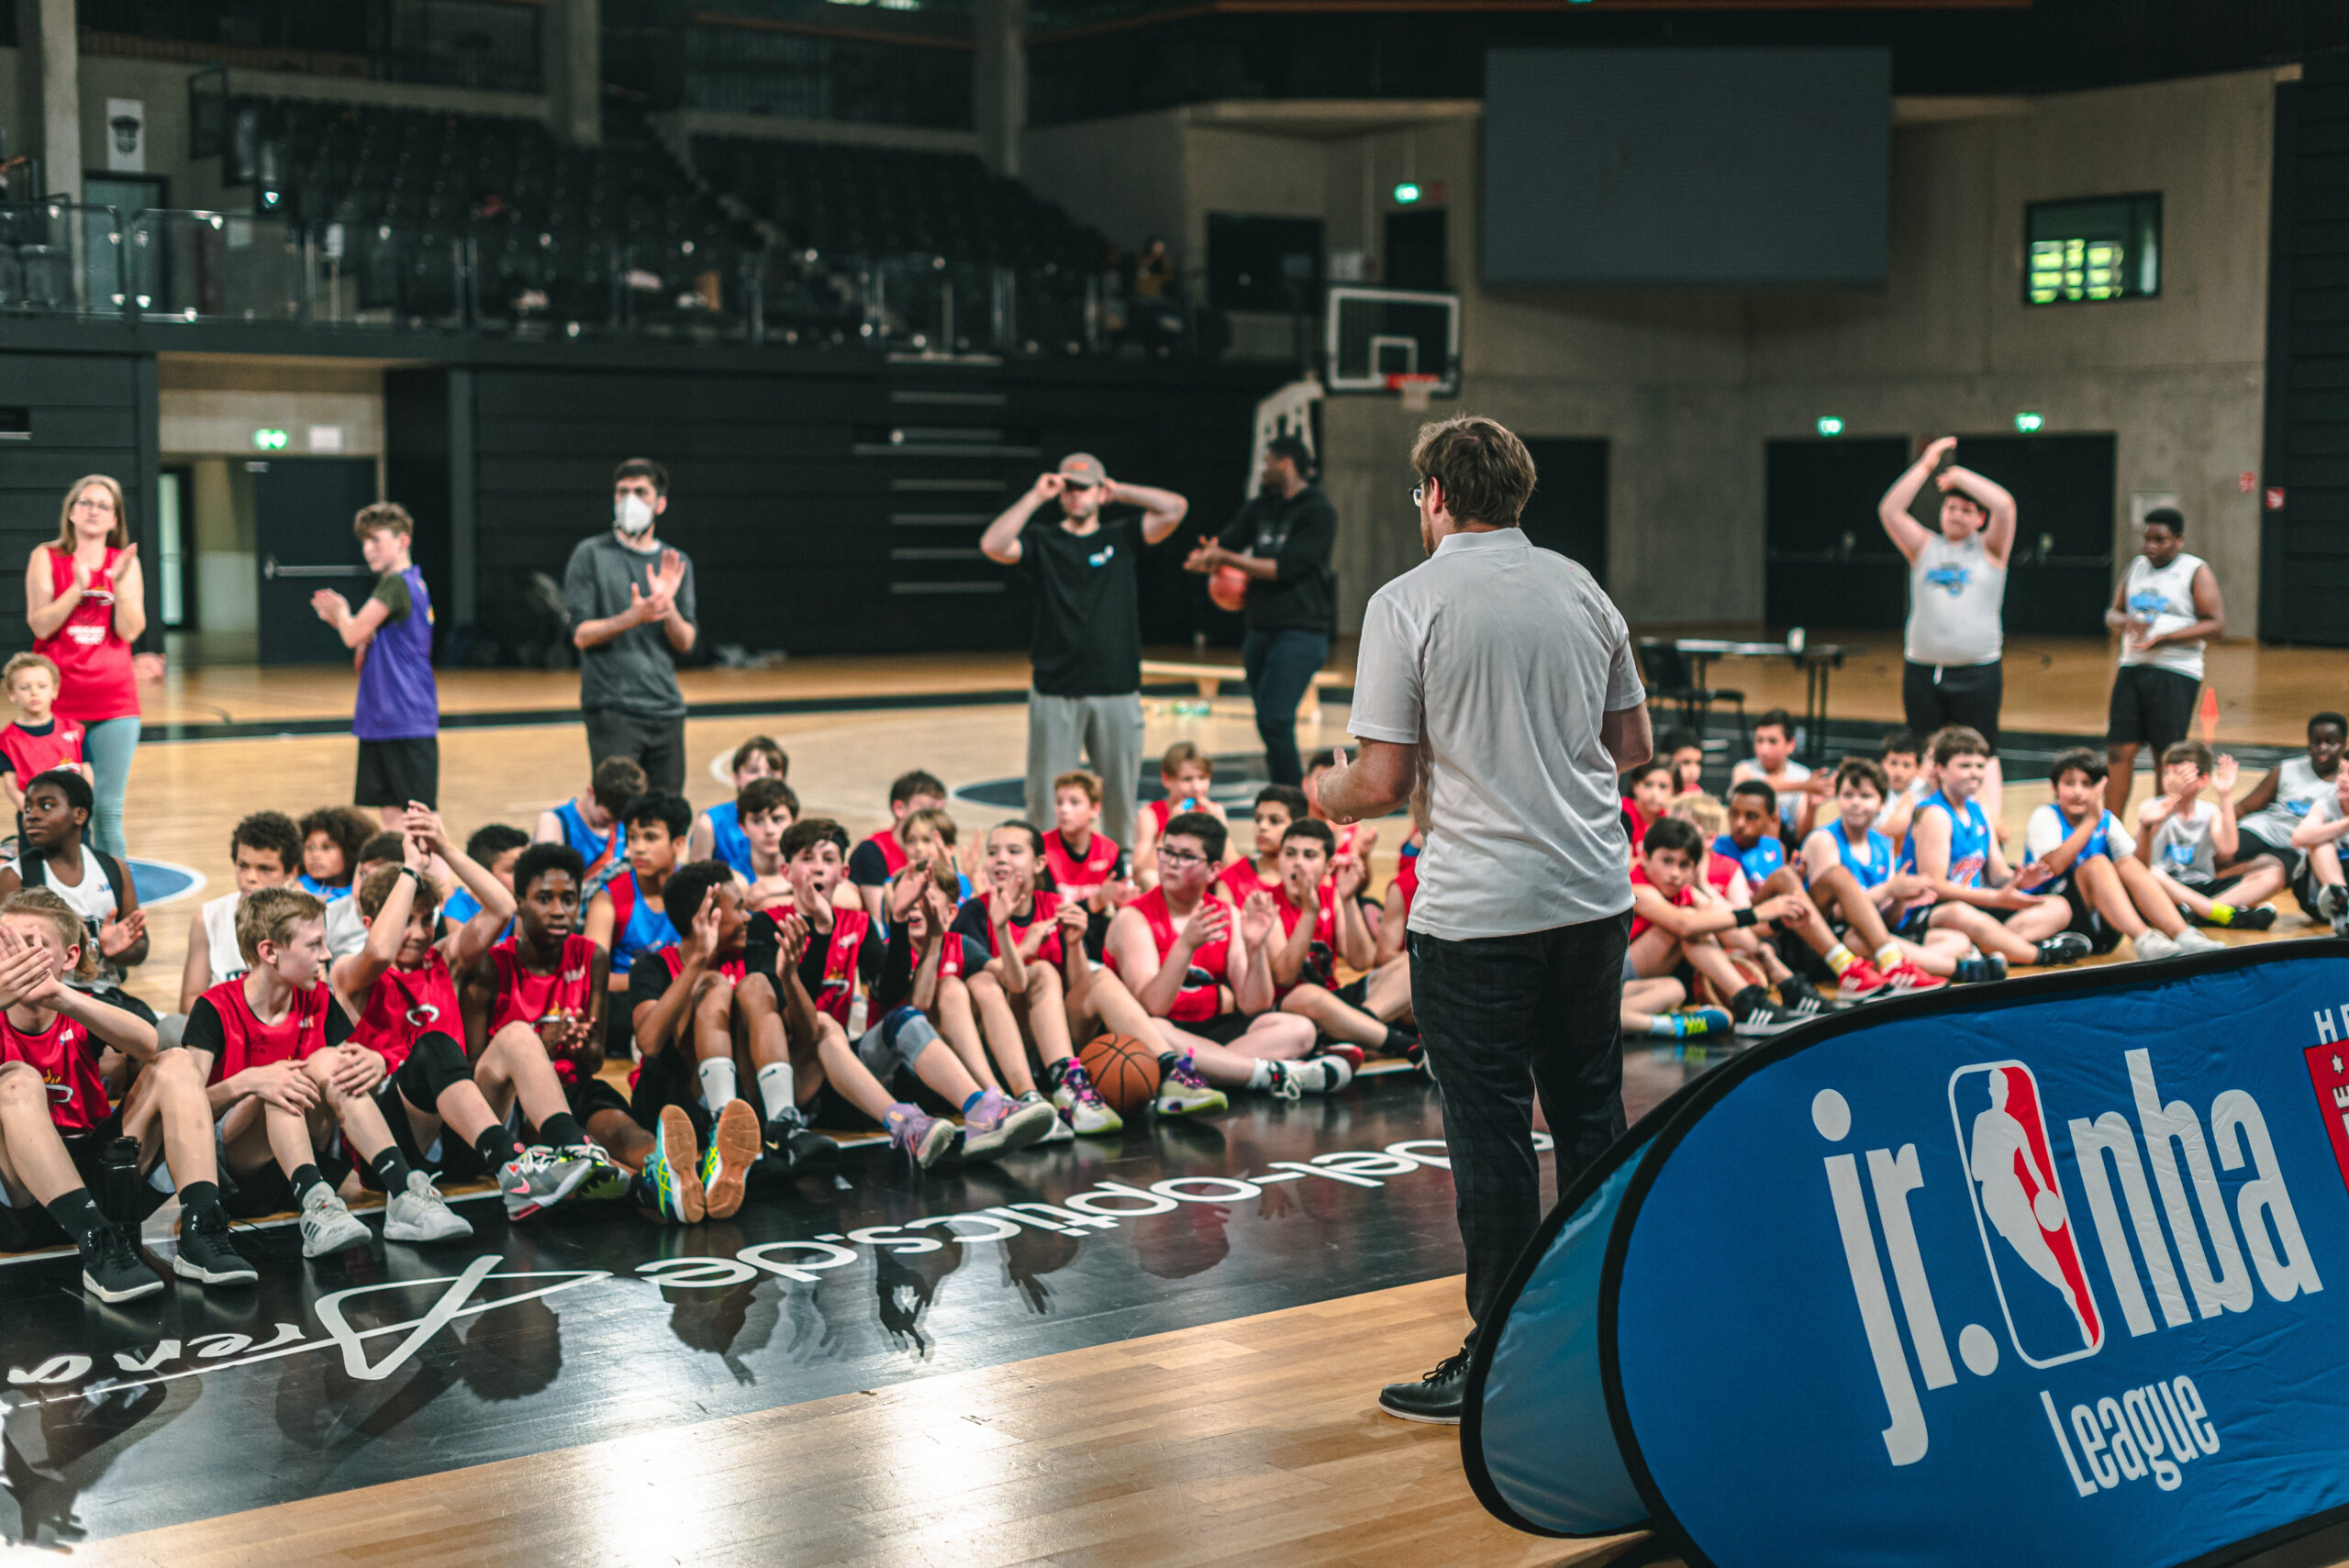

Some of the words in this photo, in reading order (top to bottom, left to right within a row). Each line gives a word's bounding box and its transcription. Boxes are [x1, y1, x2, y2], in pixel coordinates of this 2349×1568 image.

[635, 1138, 1554, 1288] del-optics.de
[1811, 1088, 1998, 1466] jr.
[2067, 1048, 2324, 1338] nba
[6, 1255, 614, 1407] Arena
[2040, 1375, 2221, 1497] League
